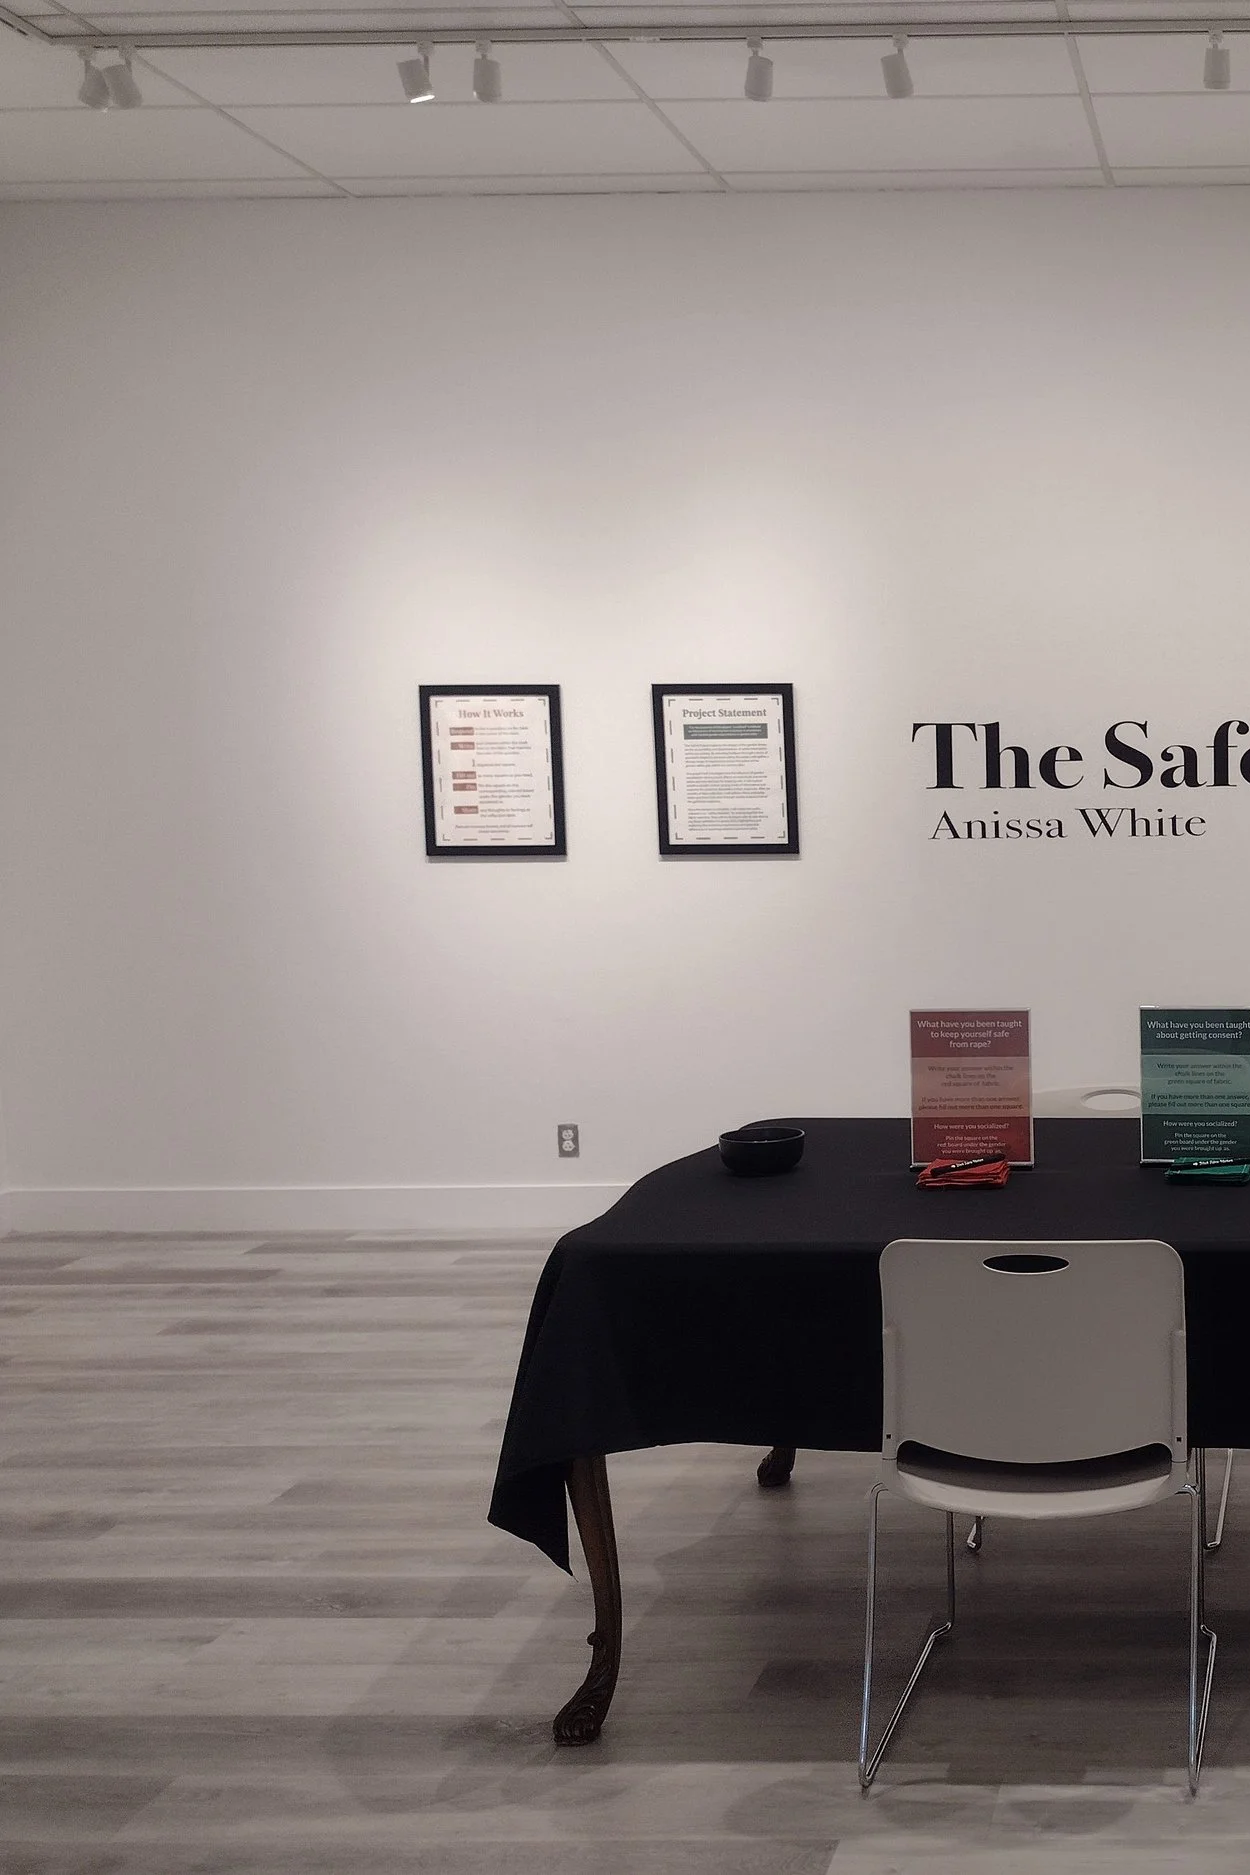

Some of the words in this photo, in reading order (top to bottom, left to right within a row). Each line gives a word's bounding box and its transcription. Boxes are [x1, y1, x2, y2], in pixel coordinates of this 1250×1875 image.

[459, 710, 480, 718] How
[484, 710, 491, 718] It
[493, 710, 524, 718] Works
[682, 709, 716, 719] Project
[718, 709, 766, 717] Statement
[912, 721, 1084, 790] The
[929, 812, 1067, 840] Anissa
[1076, 809, 1207, 838] White
[997, 1020, 1022, 1028] taught
[1190, 1022, 1203, 1030] you
[1226, 1021, 1250, 1030] taught
[941, 1031, 959, 1039] keep
[961, 1031, 991, 1039] yourself
[1180, 1031, 1207, 1040] getting
[970, 1041, 991, 1049] rape?
